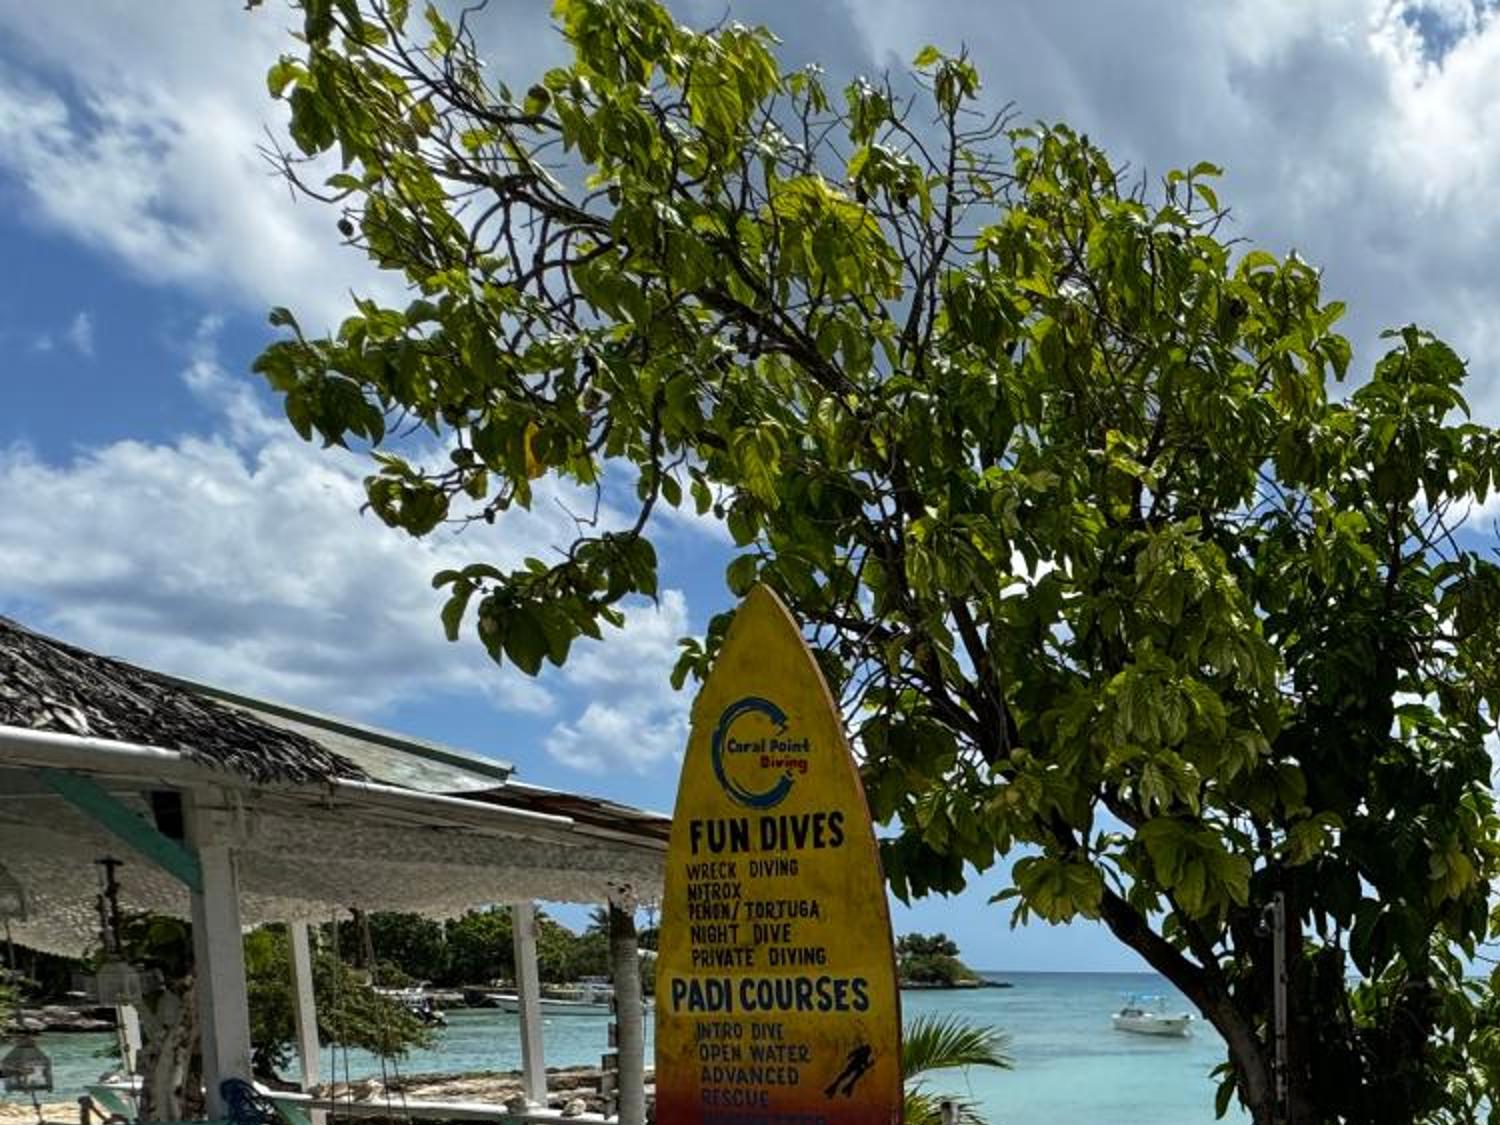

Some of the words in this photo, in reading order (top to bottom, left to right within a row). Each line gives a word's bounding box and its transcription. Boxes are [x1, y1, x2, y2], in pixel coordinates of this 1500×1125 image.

[728, 738, 766, 752] Coral
[769, 737, 810, 752] Point
[760, 755, 808, 774] Diving
[689, 817, 748, 854] FUN
[760, 811, 845, 851] DIVES
[686, 862, 737, 881] WRECK
[749, 860, 799, 877] DIVING
[687, 883, 742, 900] NITROX
[745, 900, 820, 920] TORTUGA
[691, 924, 739, 944] NIGHT
[753, 923, 791, 944] DIVE
[692, 948, 755, 967] PRIVATE
[769, 948, 827, 966] DIVING
[671, 978, 732, 1012] PADI
[739, 976, 869, 1011] COURSES
[697, 1023, 743, 1041] INTRO
[751, 1023, 784, 1040] DIVE
[699, 1043, 743, 1062] OPEN
[749, 1044, 812, 1064] WATER
[701, 1065, 800, 1085] ADVANCED
[703, 1089, 769, 1108] RESCUE
